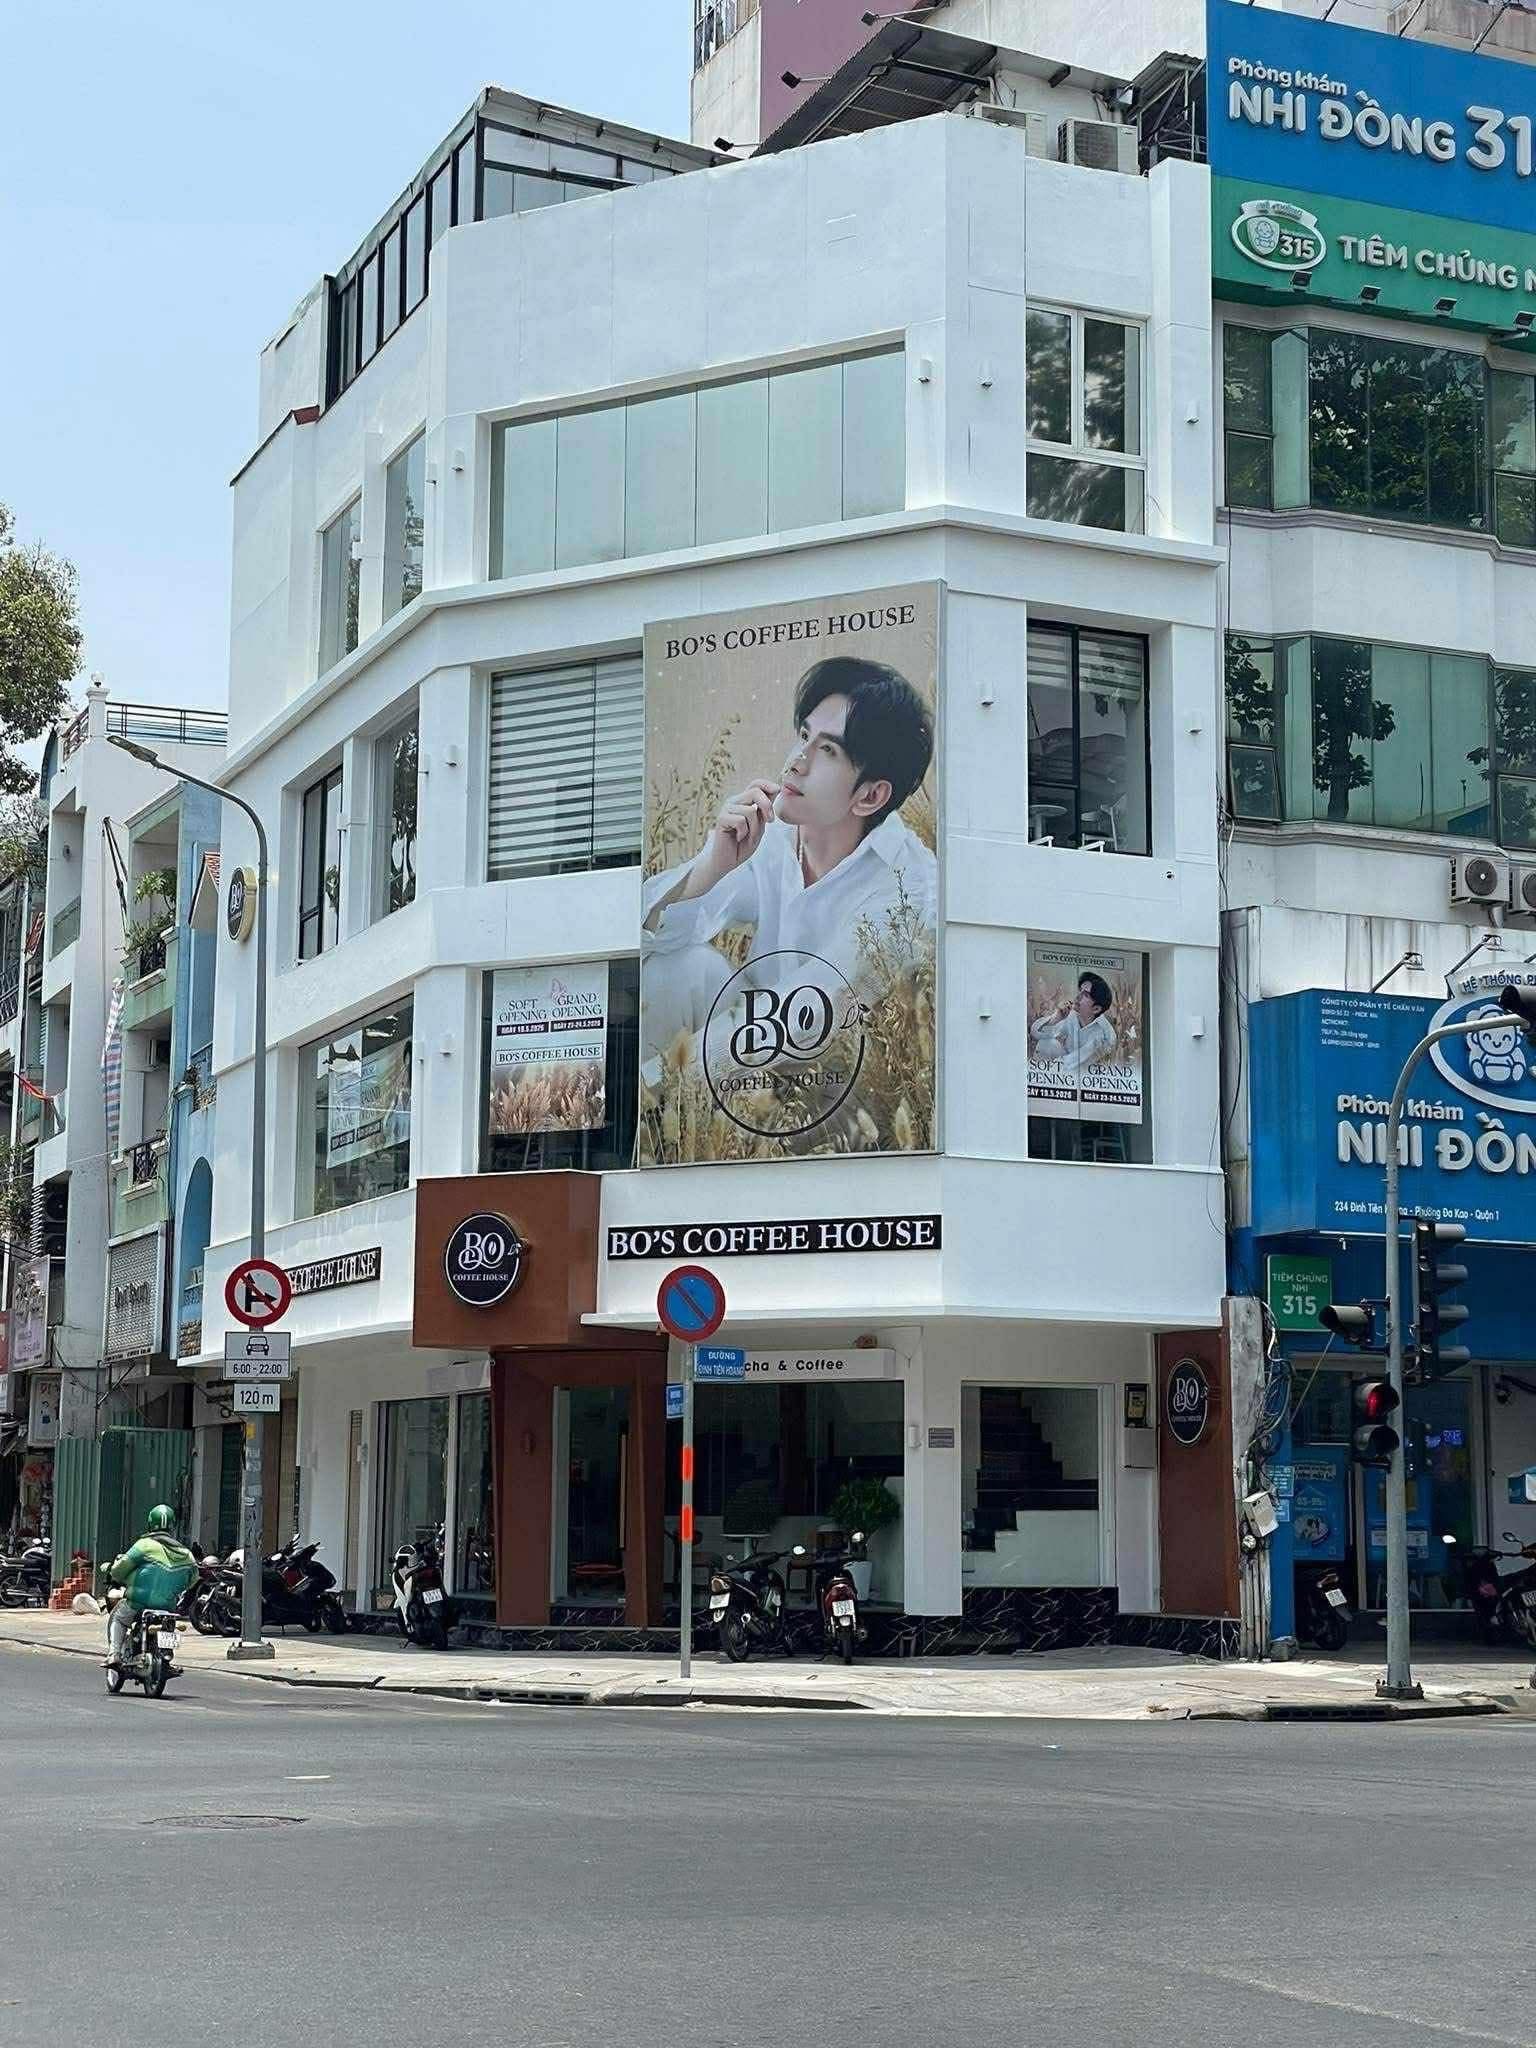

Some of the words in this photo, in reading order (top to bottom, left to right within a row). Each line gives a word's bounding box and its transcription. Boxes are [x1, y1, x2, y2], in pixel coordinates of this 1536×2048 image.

[1227, 57, 1291, 88] Phòng
[1295, 70, 1347, 96] khám
[1229, 80, 1306, 132] NHI
[1318, 90, 1456, 162] ĐỒNG
[1466, 105, 1536, 177] 31
[1280, 234, 1316, 260] 315
[1338, 233, 1408, 270] TIÊM
[664, 634, 717, 659] BO'S
[723, 618, 820, 650] COFFEE
[826, 604, 915, 635] HOUSE
[508, 998, 538, 1013] SOFT
[557, 992, 597, 1006] GRAND
[499, 1009, 547, 1023] OPENING
[552, 1004, 602, 1018] OPENING
[730, 985, 834, 1068] BO
[499, 1052, 520, 1063] BO'S
[521, 1049, 561, 1061] COFFEE
[563, 1046, 600, 1057] HOUSE
[1029, 1058, 1064, 1073] SOFT
[1087, 1063, 1133, 1078] GRAND
[1082, 1076, 1138, 1092] OPENING
[1407, 1098, 1464, 1121] khám
[1337, 1120, 1423, 1167] NHI
[1334, 1201, 1349, 1212] 234
[609, 1228, 676, 1257] BO'S
[682, 1224, 809, 1253] COFFEE
[818, 1219, 935, 1249] HOUSE
[458, 1231, 505, 1271] BO
[482, 1273, 509, 1281] HOUSE
[1282, 1295, 1317, 1315] 315
[260, 1364, 282, 1375] 22:00
[743, 1359, 769, 1372] cha
[778, 1360, 787, 1371] &
[795, 1359, 844, 1371] Coffee
[240, 1390, 260, 1405] 120
[262, 1394, 274, 1405] m
